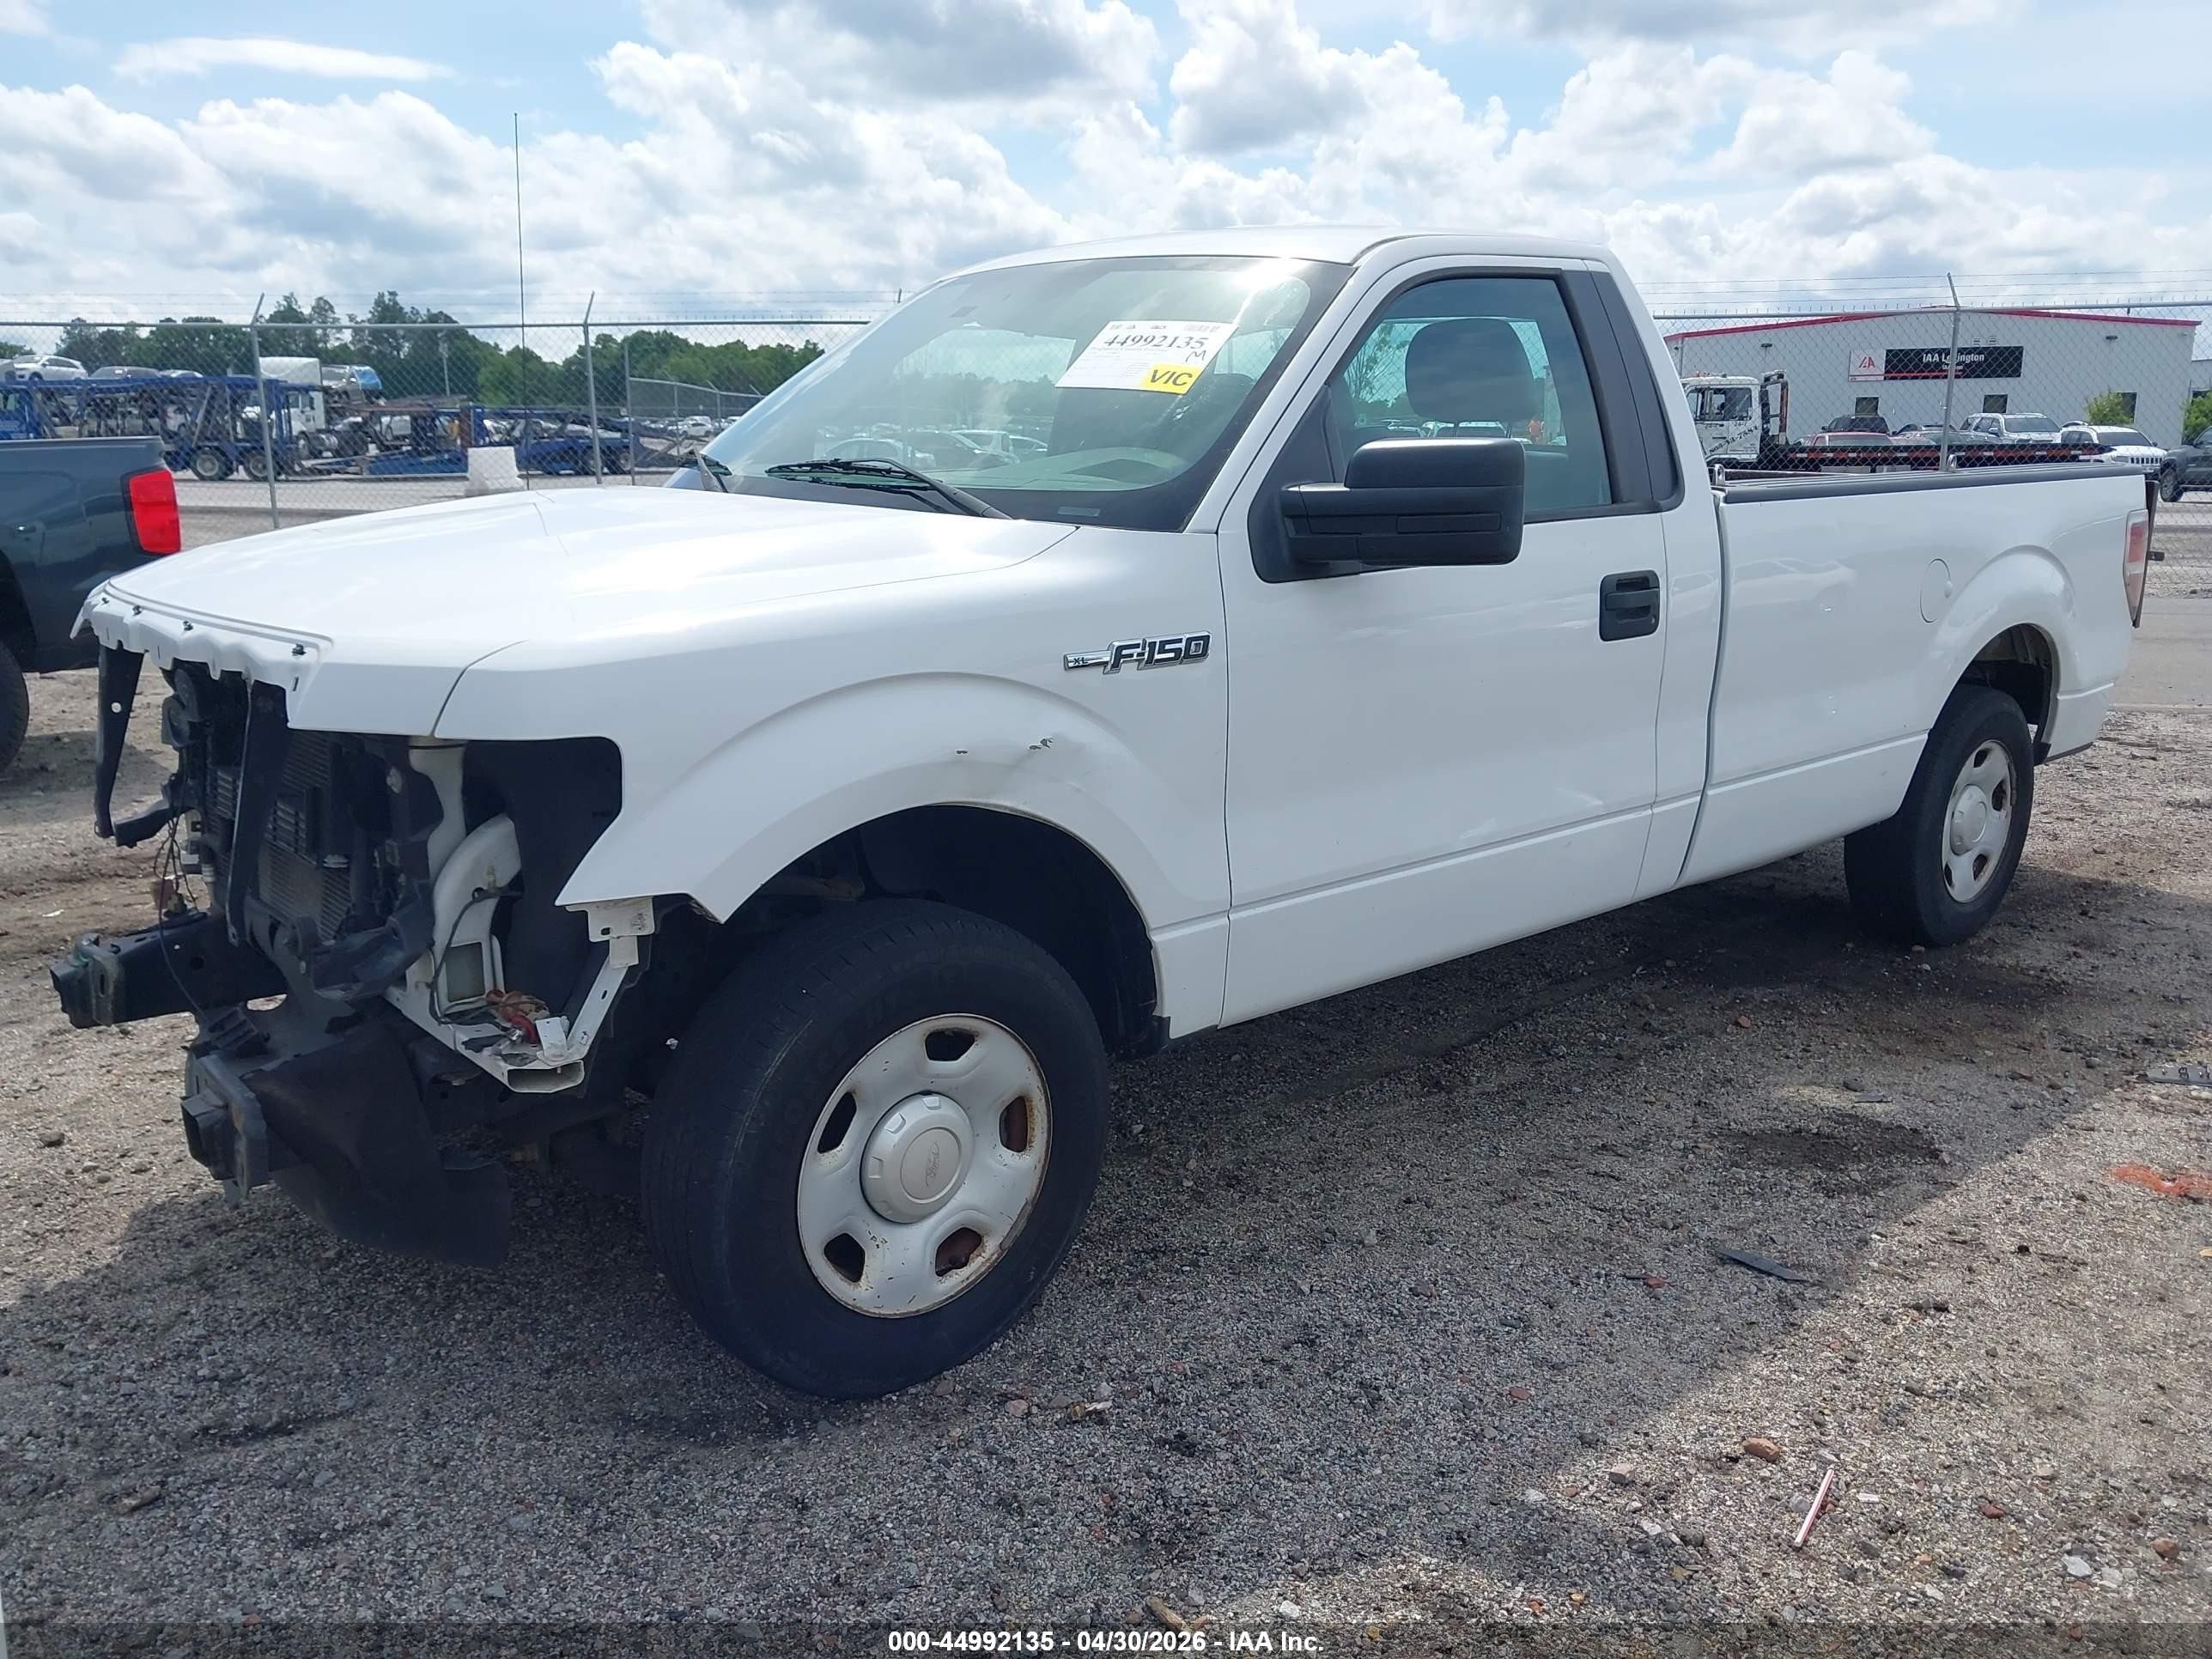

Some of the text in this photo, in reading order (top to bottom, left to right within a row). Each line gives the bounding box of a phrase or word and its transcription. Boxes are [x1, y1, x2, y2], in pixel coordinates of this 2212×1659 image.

[1103, 334, 1209, 349] 44992135
[1923, 352, 1985, 363] IAA Leington
[1150, 369, 1193, 386] VIC
[1073, 631, 1212, 673] XL F-150
